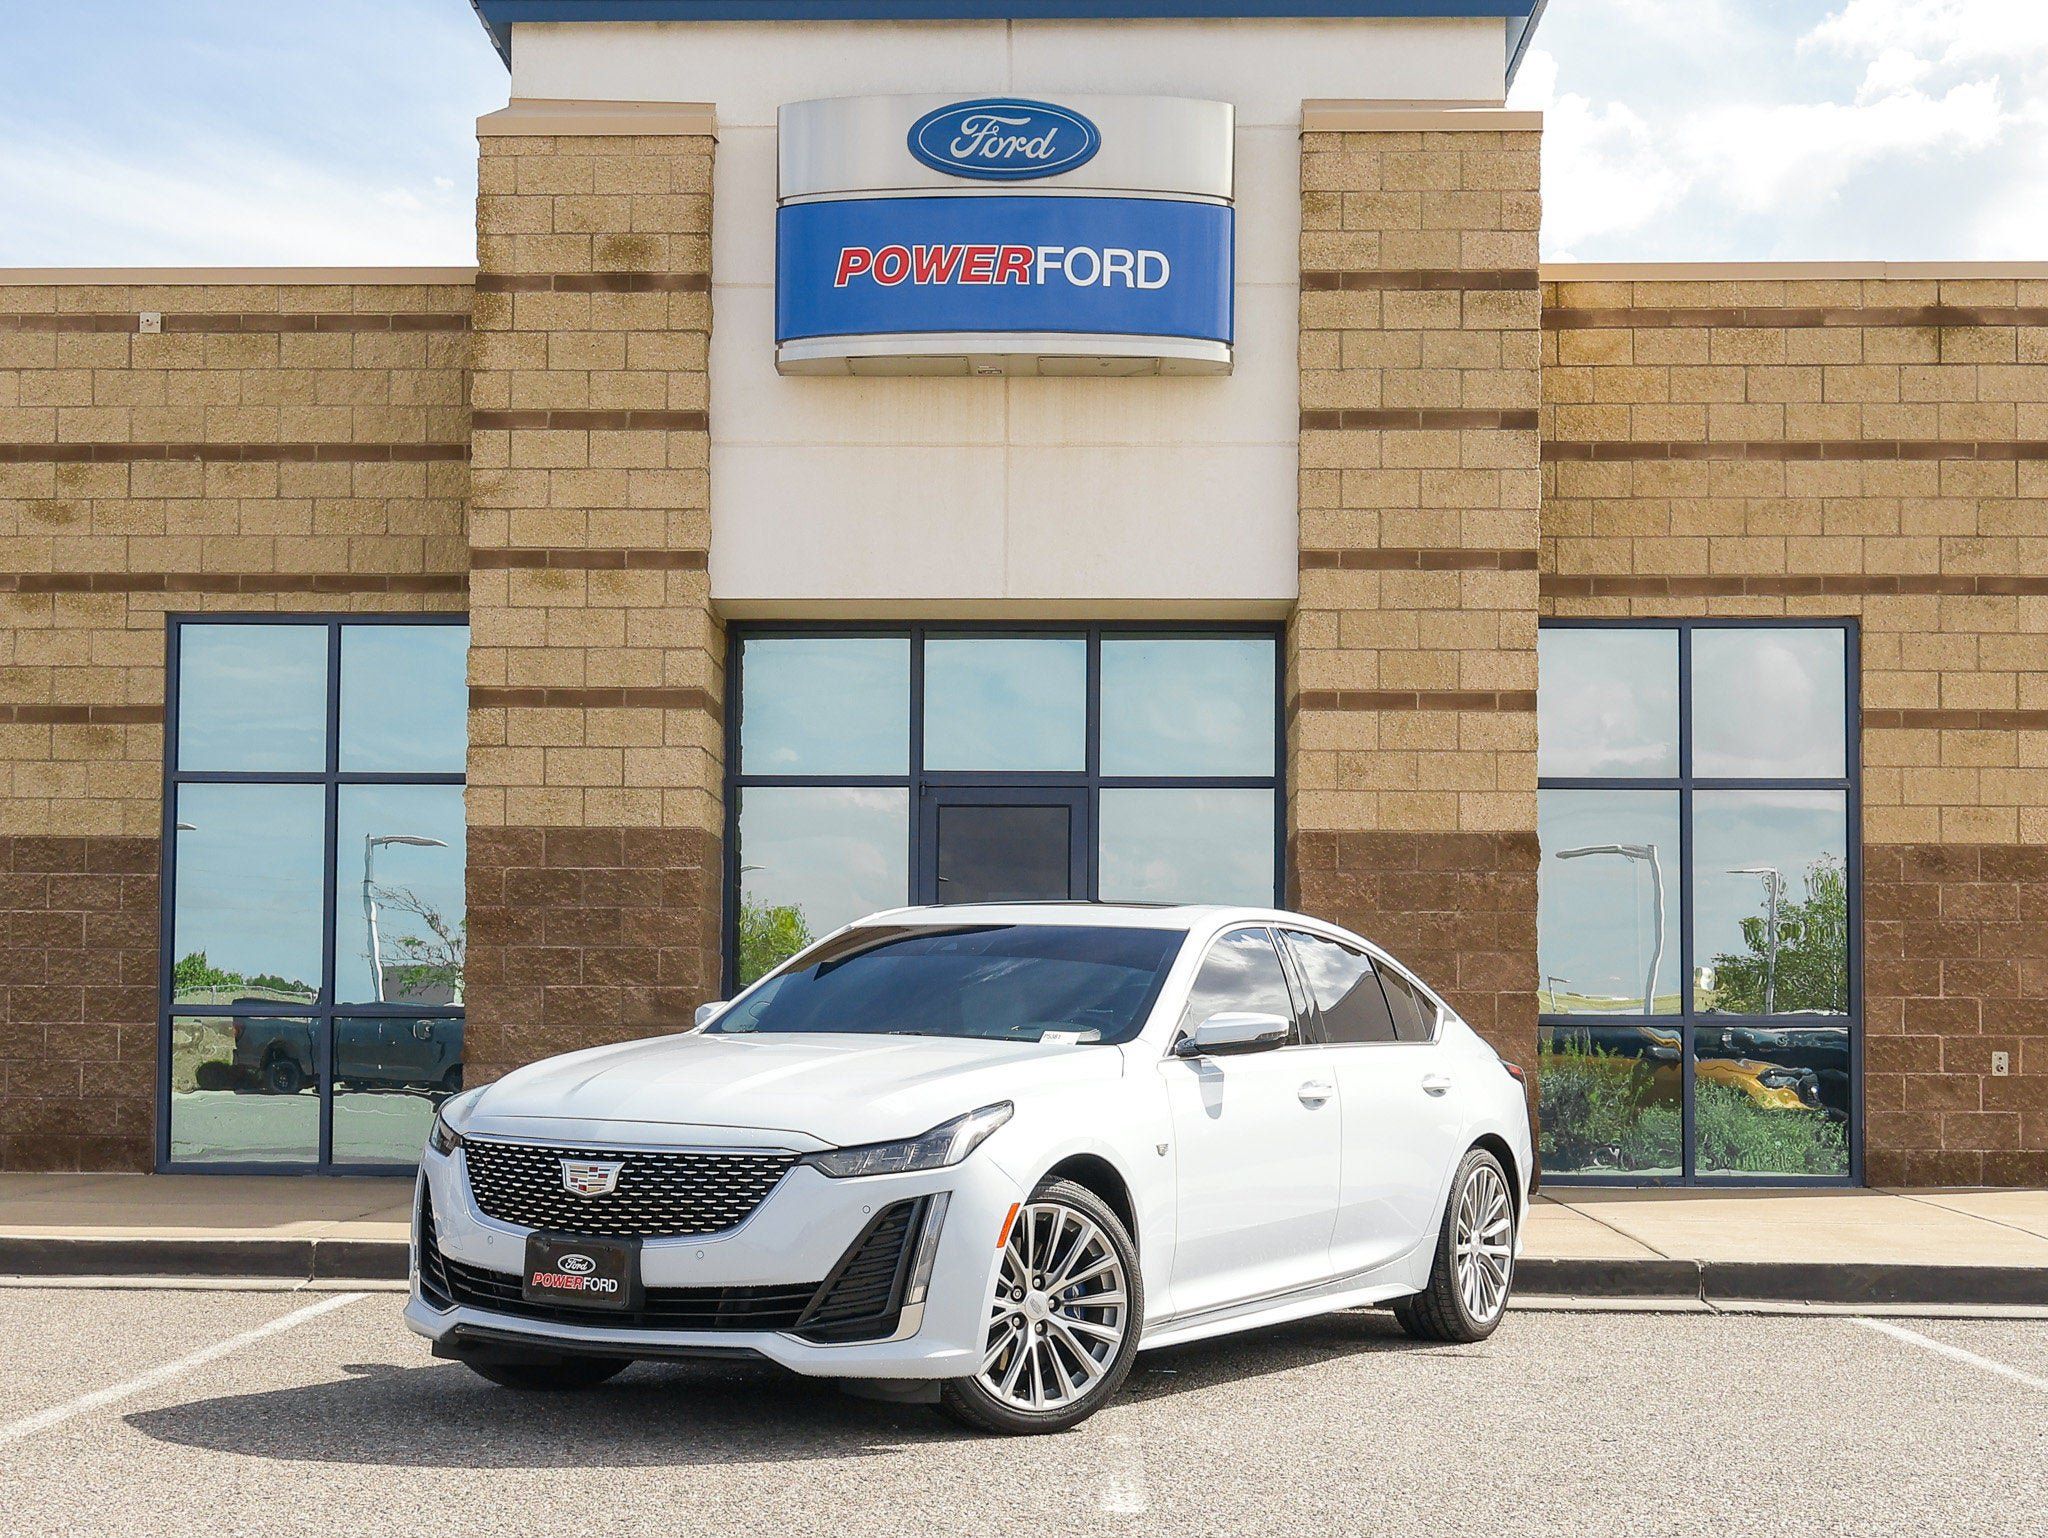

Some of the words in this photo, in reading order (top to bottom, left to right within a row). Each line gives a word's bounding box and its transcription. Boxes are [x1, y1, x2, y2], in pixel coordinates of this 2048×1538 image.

[950, 114, 1058, 159] Ford
[833, 244, 1171, 289] POWERFORD
[565, 1257, 588, 1271] Ford
[532, 1272, 618, 1293] POWERFORD
